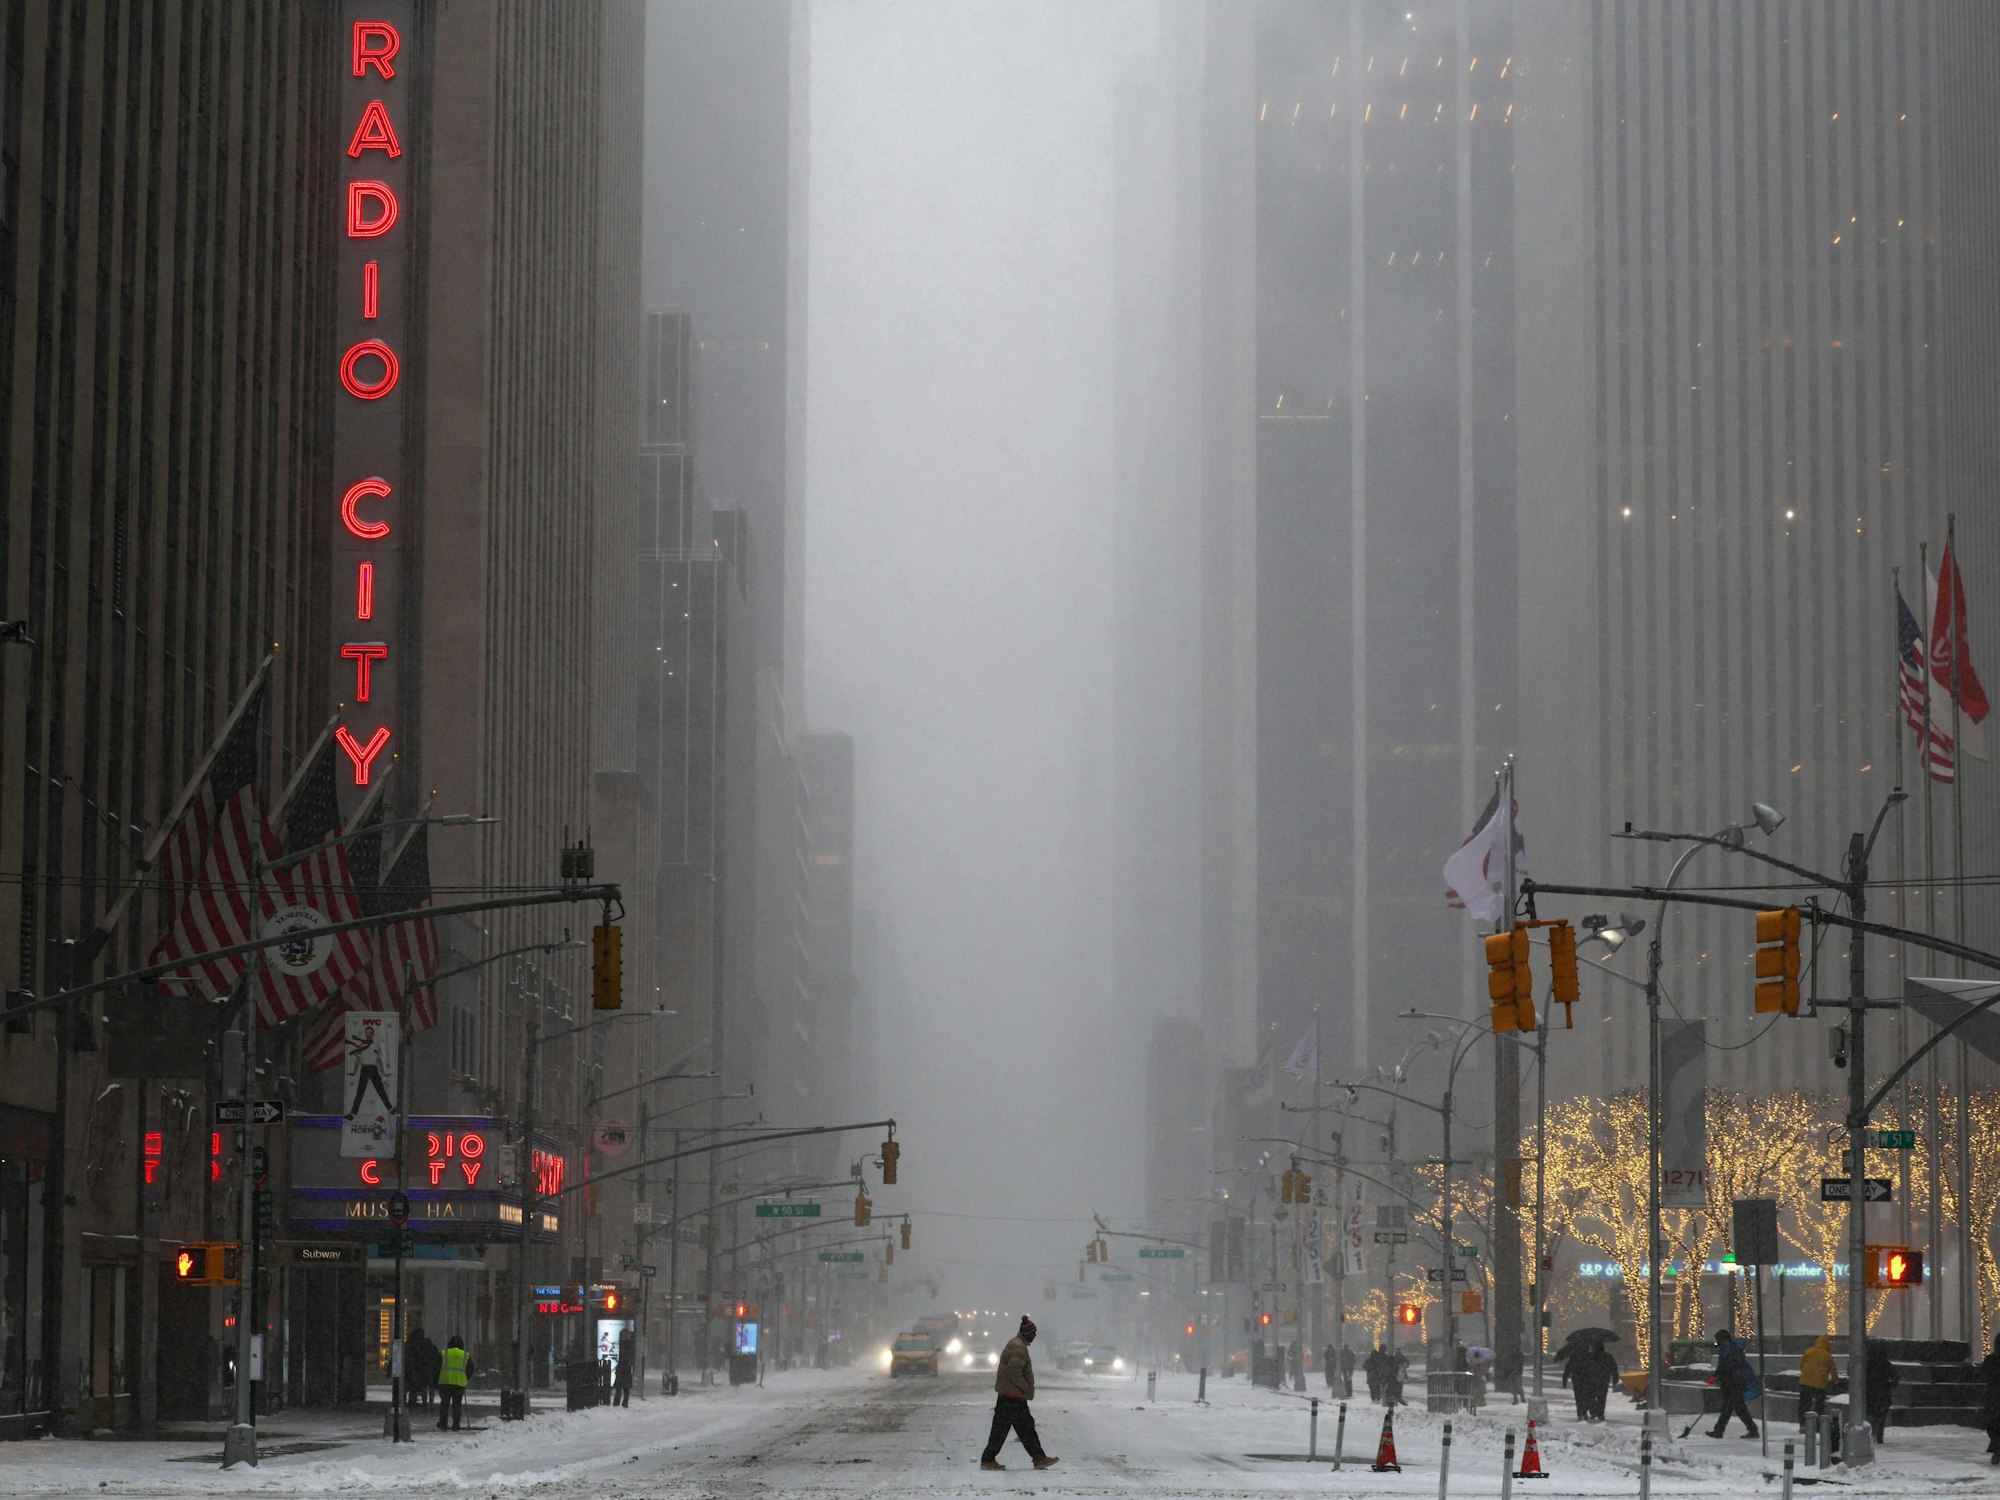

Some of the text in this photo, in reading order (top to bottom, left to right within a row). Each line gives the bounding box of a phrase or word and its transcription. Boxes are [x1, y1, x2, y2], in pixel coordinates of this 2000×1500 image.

[335, 20, 402, 786] RADIO CITY
[275, 911, 319, 925] VENEZUELA
[225, 1106, 274, 1118] ONE WAY
[1880, 1133, 1889, 1146] W
[1892, 1133, 1903, 1147] 51
[360, 1160, 482, 1185] CTY
[1664, 1170, 1703, 1188] 1271
[1829, 1186, 1848, 1195] ONE
[772, 1207, 779, 1215] W
[782, 1207, 792, 1215] 50
[302, 1248, 341, 1261] Subway
[1579, 1263, 1602, 1276] S&P
[1771, 1262, 1822, 1277] Weather
[539, 1303, 570, 1314] NBC
